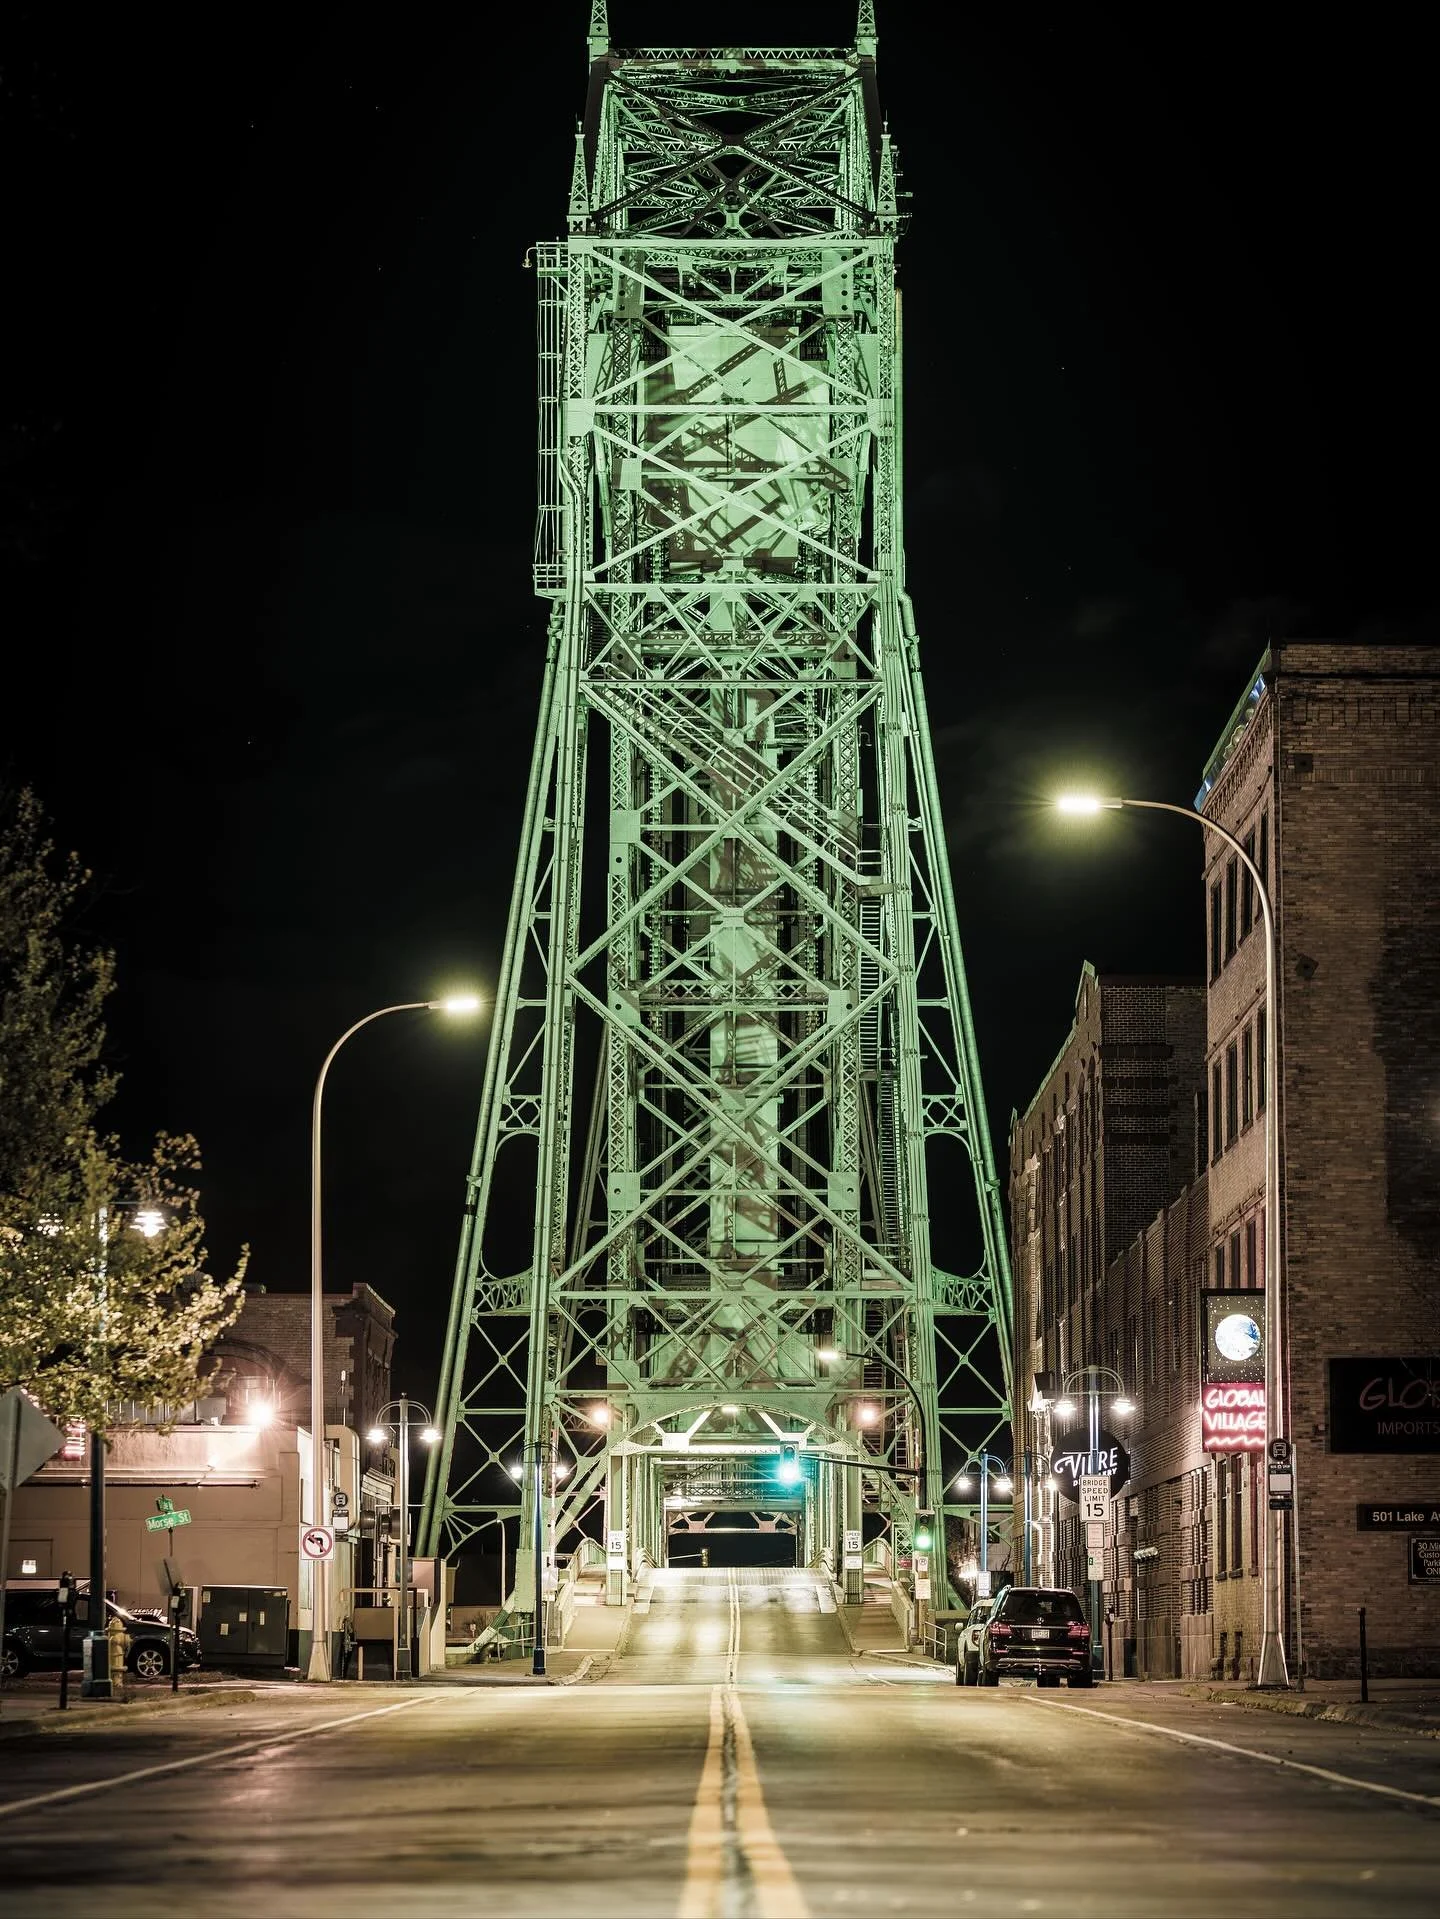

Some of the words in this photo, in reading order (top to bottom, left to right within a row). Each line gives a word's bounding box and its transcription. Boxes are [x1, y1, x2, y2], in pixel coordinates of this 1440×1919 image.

[1086, 1503, 1104, 1517] 15
[178, 1511, 189, 1523] St
[1372, 1511, 1393, 1522] 501
[1396, 1511, 1425, 1522] Lake
[611, 1541, 622, 1550] 15
[848, 1541, 859, 1549] 15
[1417, 1542, 1428, 1551] 30
